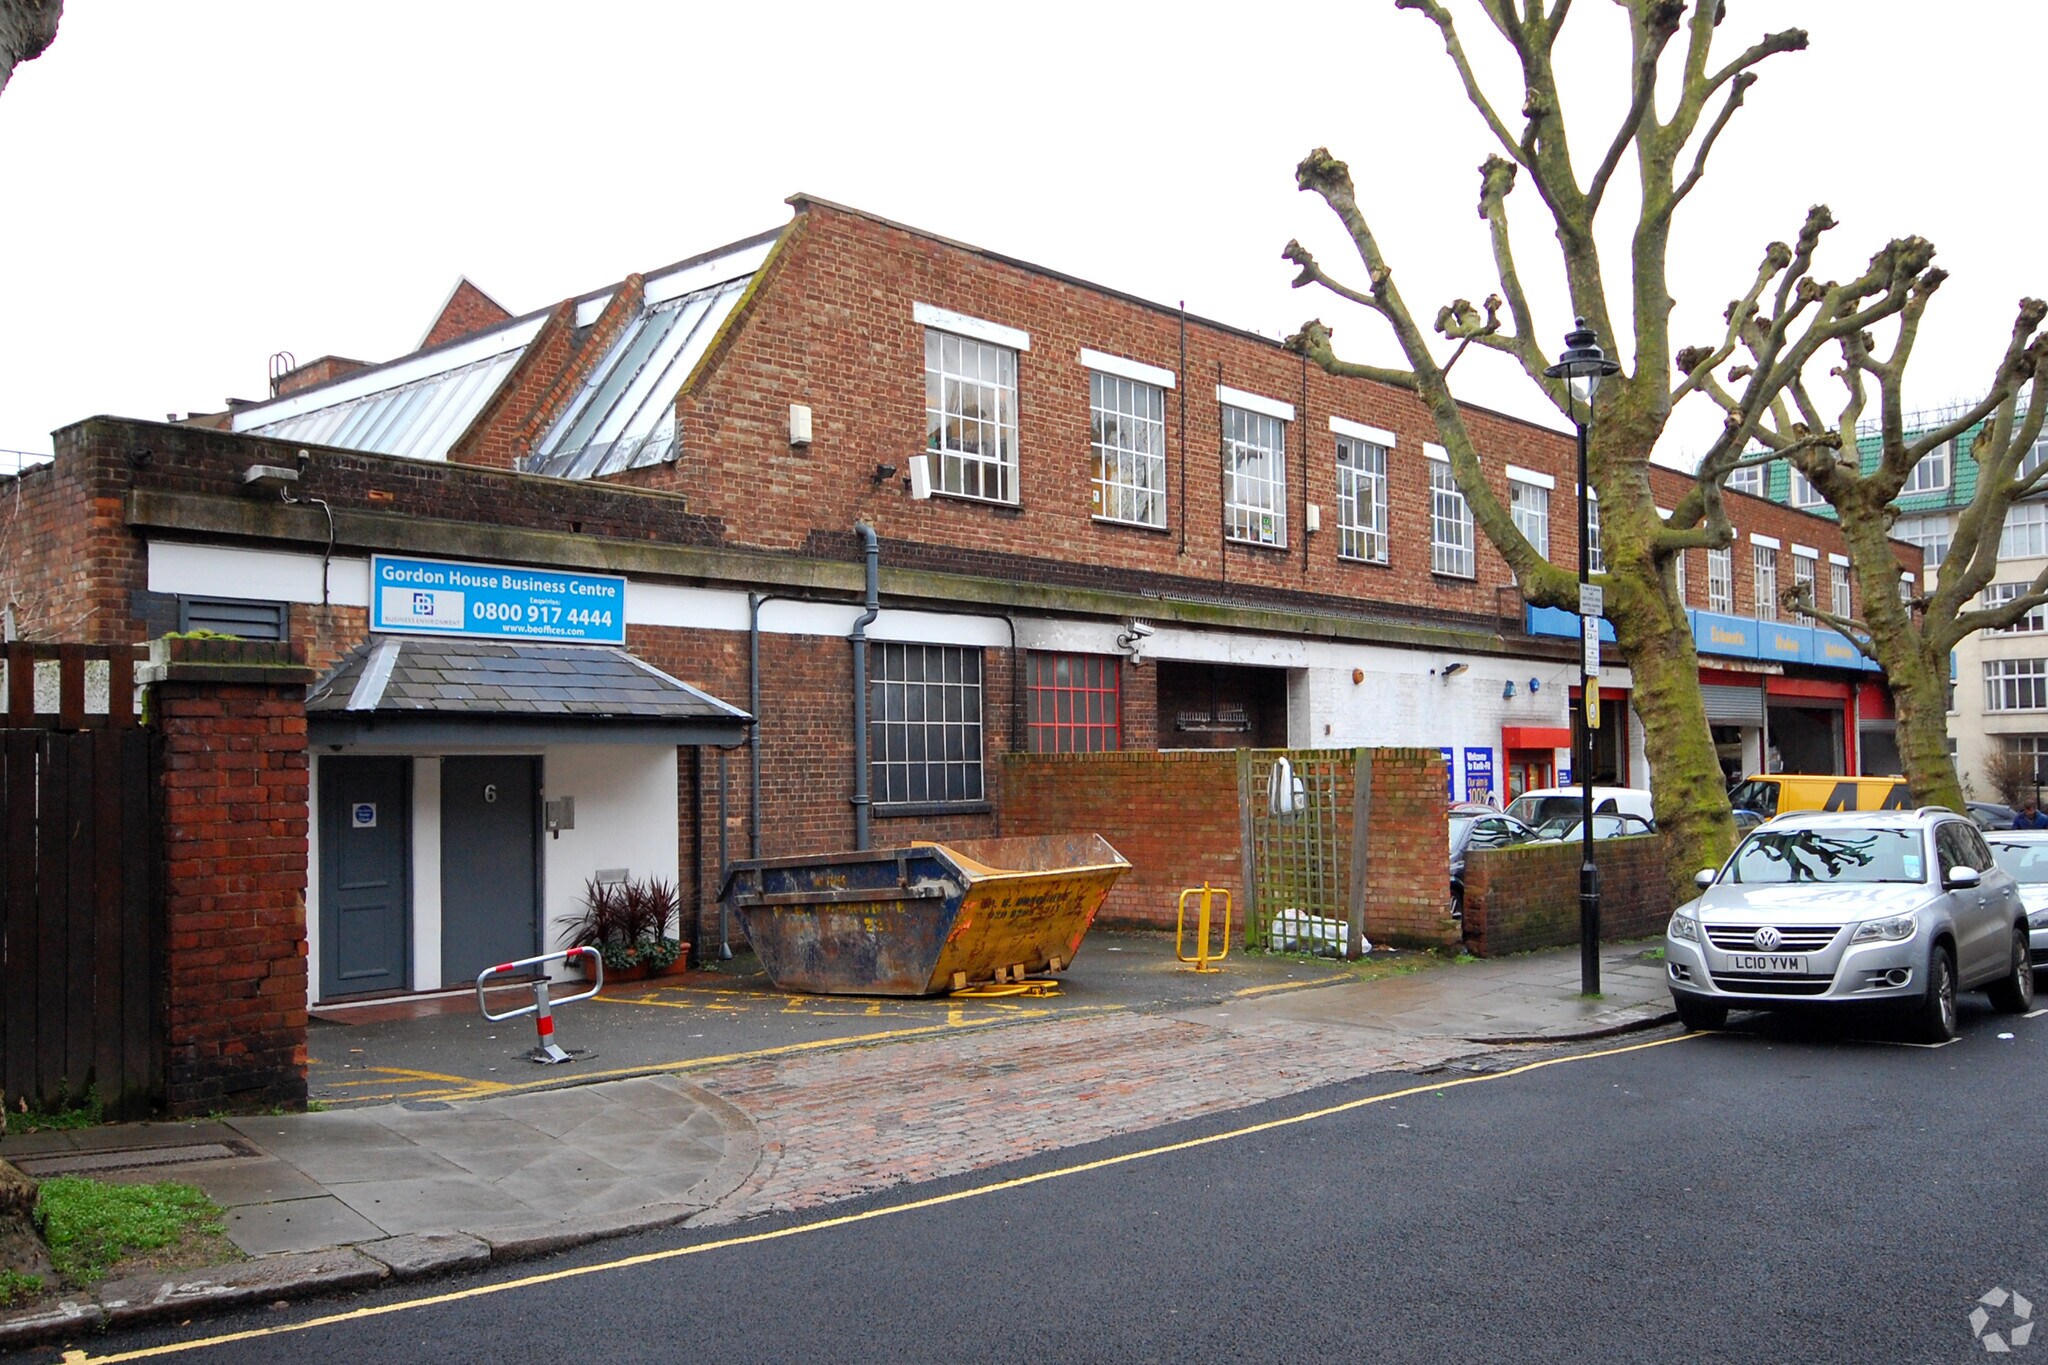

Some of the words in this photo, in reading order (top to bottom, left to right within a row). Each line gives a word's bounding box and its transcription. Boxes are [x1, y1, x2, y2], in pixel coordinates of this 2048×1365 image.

[382, 565, 444, 584] Gordon
[449, 571, 498, 587] House
[502, 575, 566, 594] Business
[569, 581, 616, 597] Centre
[473, 602, 522, 621] 0800
[527, 606, 562, 624] 917
[567, 609, 612, 627] 4444
[385, 616, 415, 624] BUSINESS
[416, 618, 460, 626] ENVIRONMENT
[502, 624, 585, 636] www.beoffices.com
[1466, 752, 1487, 761] Welcome
[1467, 761, 1473, 770] to
[1468, 777, 1476, 787] Our
[484, 784, 497, 803] 6
[1735, 956, 1766, 969] LC10
[1770, 957, 1799, 970] YVM
